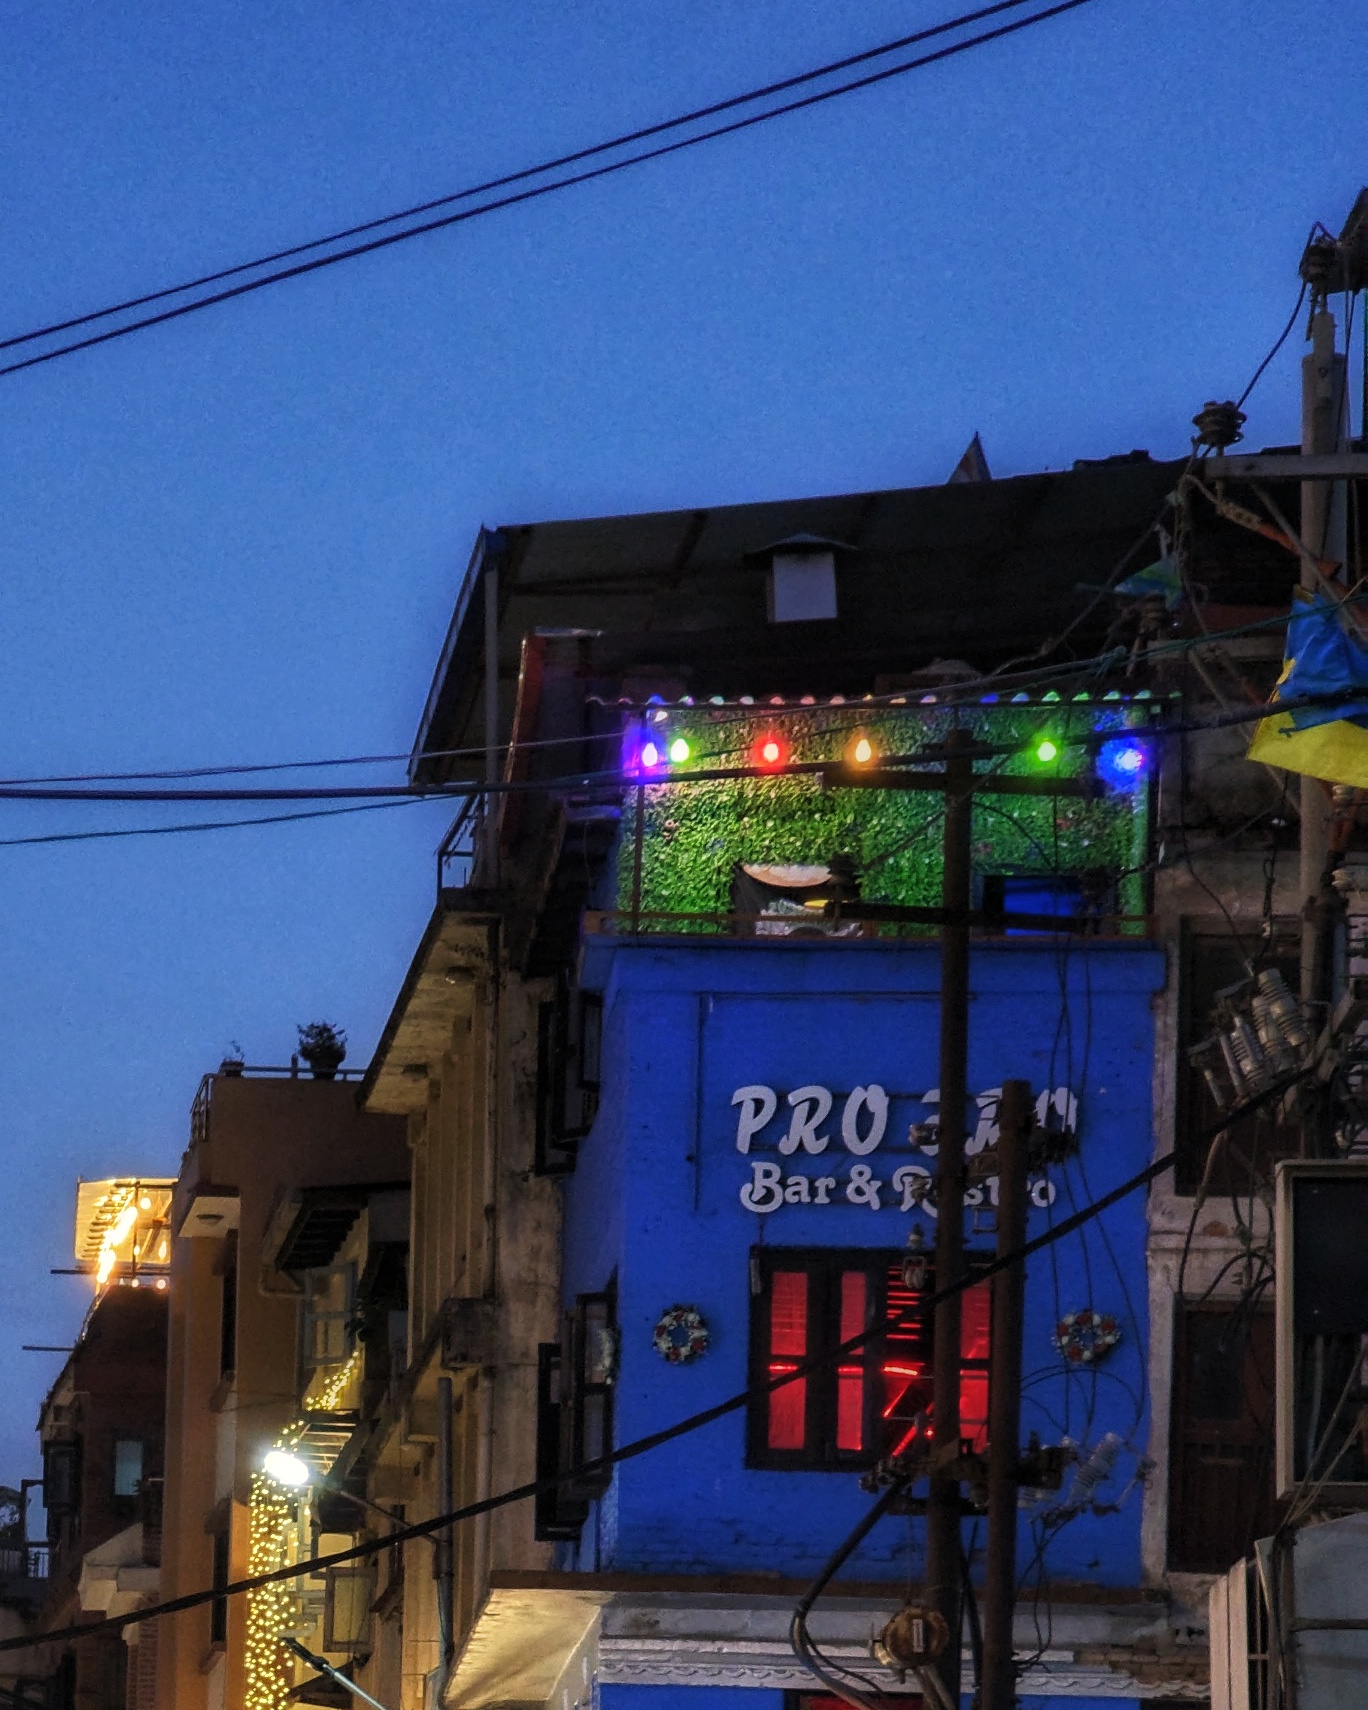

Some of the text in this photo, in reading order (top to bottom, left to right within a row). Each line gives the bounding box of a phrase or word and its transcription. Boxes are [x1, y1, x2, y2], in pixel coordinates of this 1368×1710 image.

[731, 1084, 889, 1155] PRO
[740, 1162, 836, 1213] Bar
[846, 1164, 881, 1211] &
